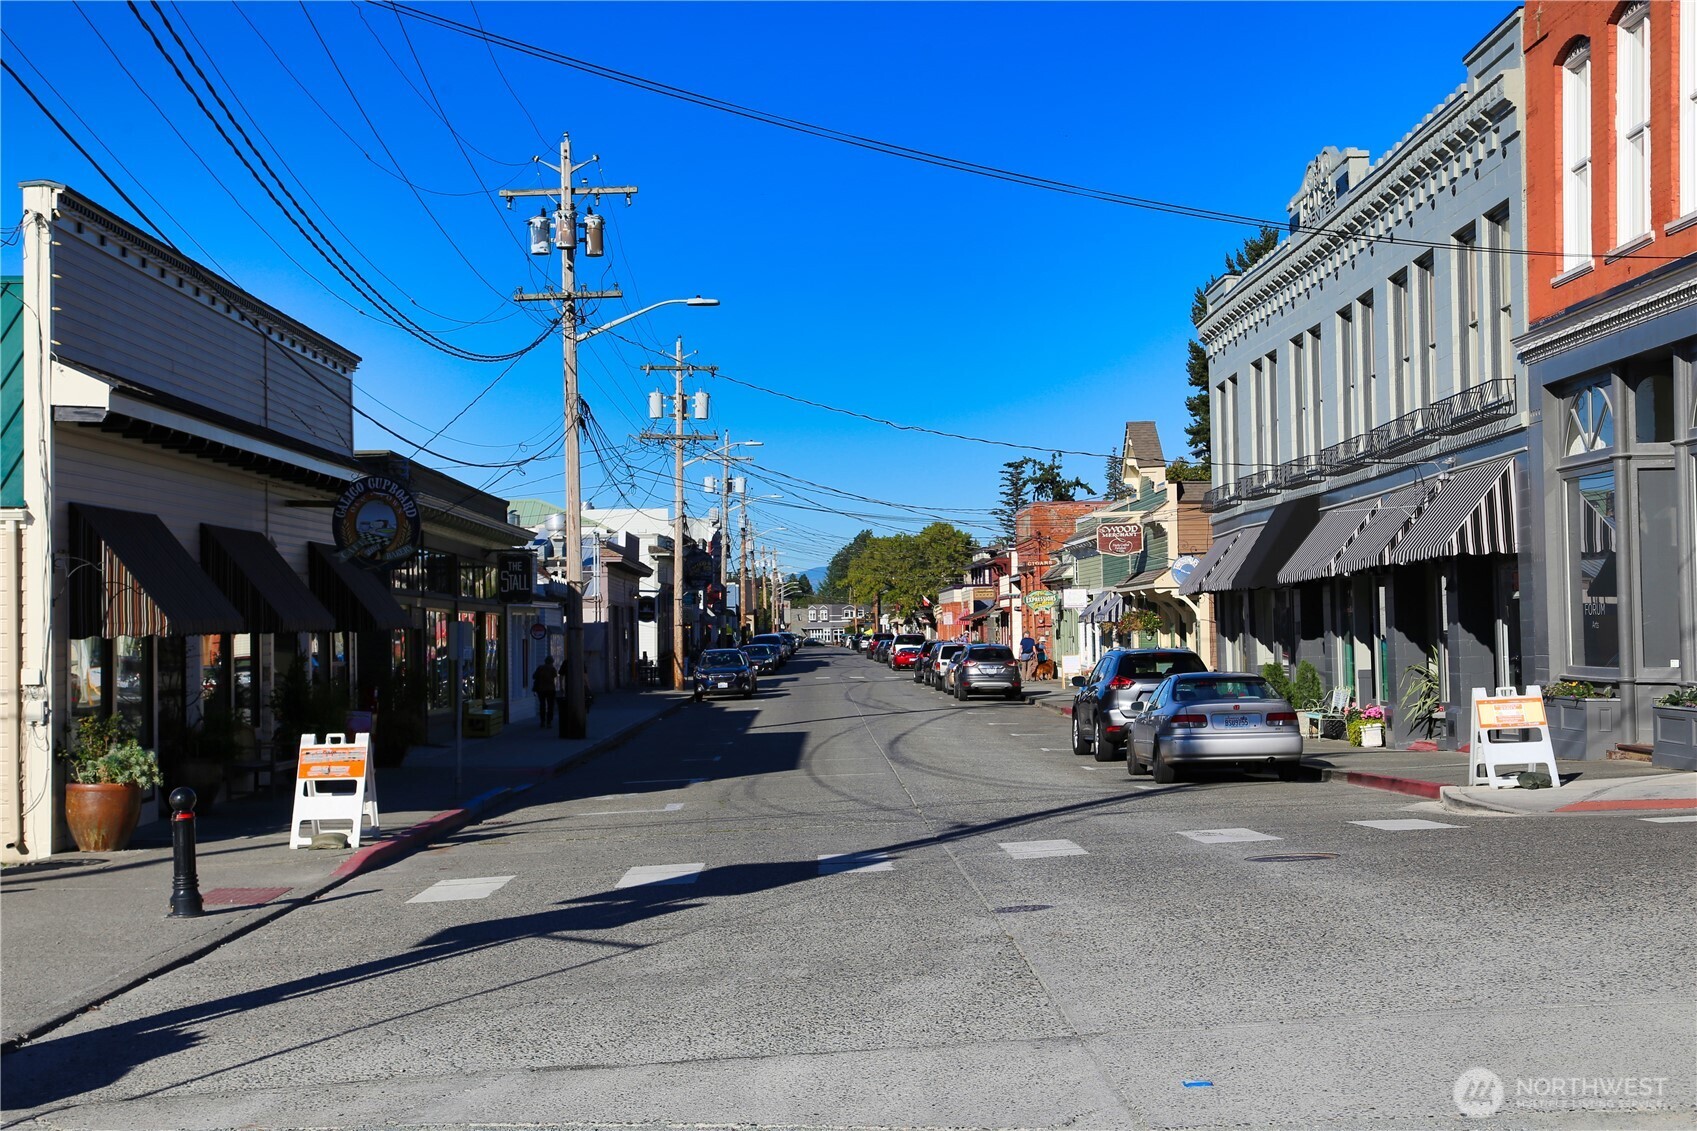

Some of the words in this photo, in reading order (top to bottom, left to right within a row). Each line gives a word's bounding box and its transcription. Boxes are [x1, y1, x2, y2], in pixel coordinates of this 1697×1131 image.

[334, 482, 365, 519] CALICO
[367, 477, 418, 519] CUPBOARD
[385, 544, 413, 560] BAKERY
[507, 561, 523, 572] THE
[500, 570, 530, 593] STALL
[1584, 603, 1606, 616] FORUM
